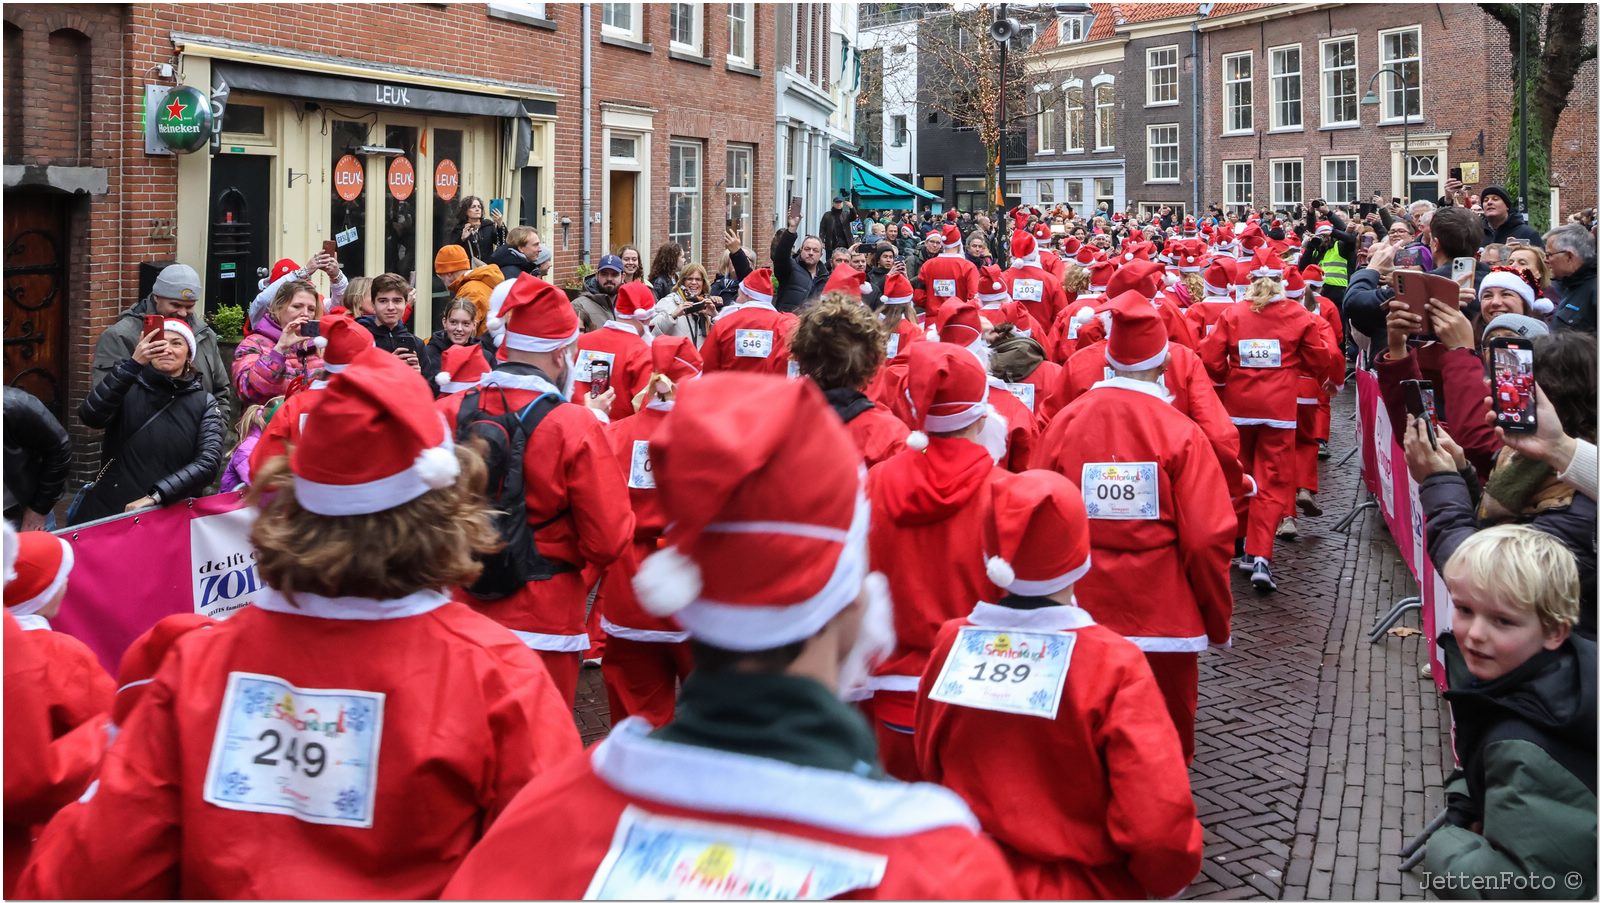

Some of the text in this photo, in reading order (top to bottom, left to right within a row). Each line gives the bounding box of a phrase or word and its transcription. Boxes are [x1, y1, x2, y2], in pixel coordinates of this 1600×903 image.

[376, 84, 410, 106] LEUK
[158, 123, 200, 134] Heineken
[336, 171, 363, 185] LEUK
[390, 172, 414, 186] LEUK
[436, 173, 458, 186] LEUK
[1020, 286, 1035, 294] 103
[742, 339, 762, 349] 546
[1248, 349, 1270, 359] 118
[1097, 484, 1135, 500] 008
[199, 552, 245, 574] delft
[968, 661, 1031, 684] 189
[253, 728, 327, 779] 249
